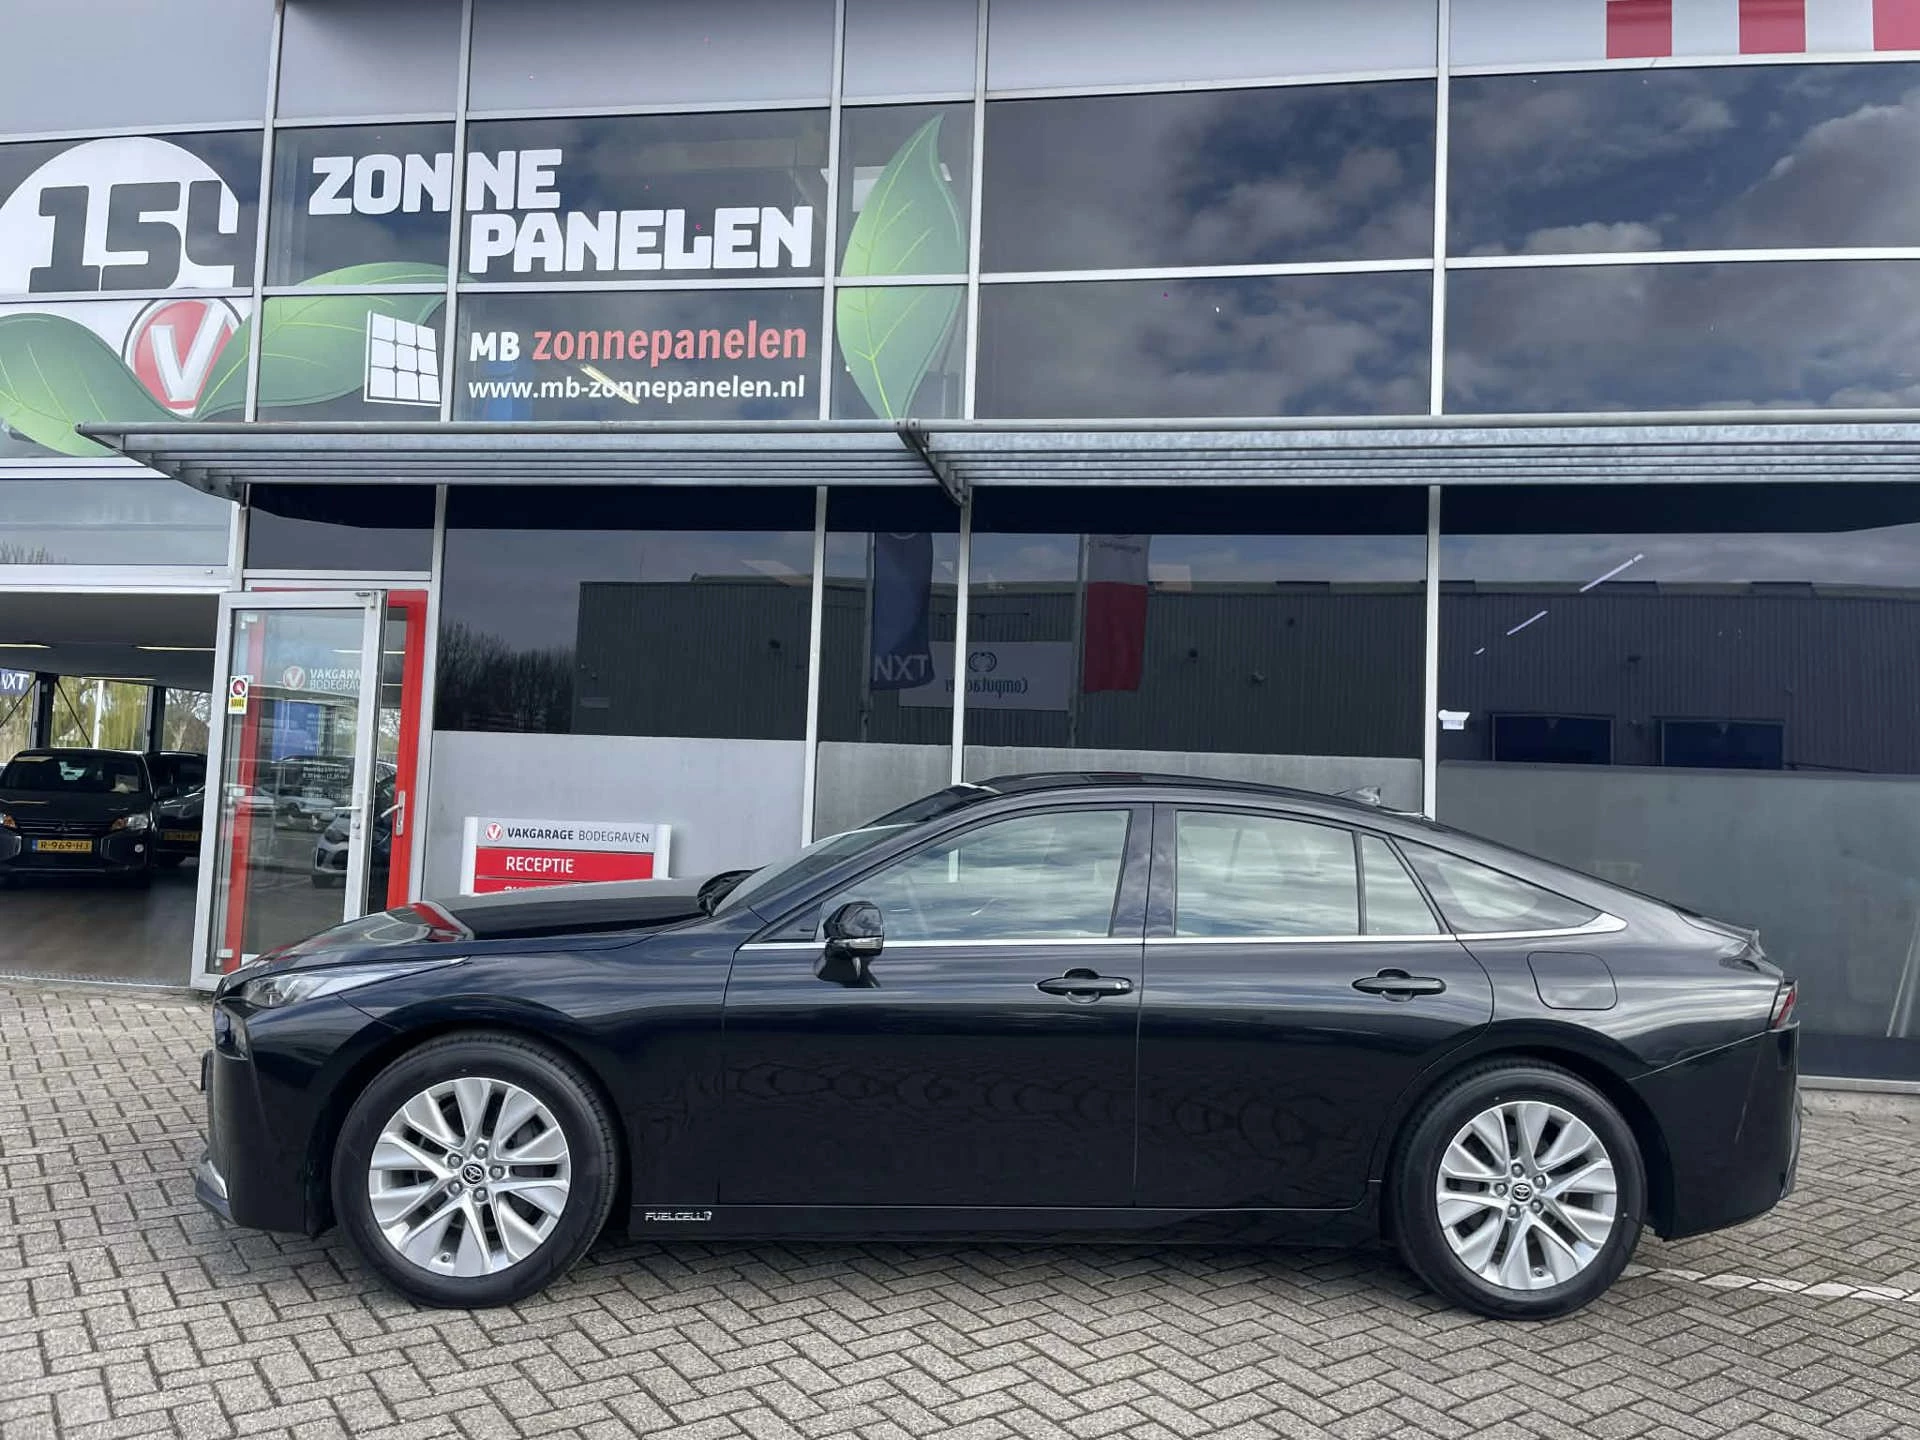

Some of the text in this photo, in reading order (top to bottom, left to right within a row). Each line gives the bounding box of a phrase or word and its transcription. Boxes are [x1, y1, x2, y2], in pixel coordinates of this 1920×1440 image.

[308, 148, 563, 216] ZONNE
[29, 180, 250, 293] 154
[468, 205, 814, 275] PANELEN
[469, 319, 808, 368] MB zonnepanelen
[467, 374, 805, 404] www.mb-zonnepanelen.nl
[873, 653, 929, 682] NXT
[507, 827, 574, 841] VAKGARAGE
[578, 829, 650, 844] BODEGRAVEN
[505, 855, 575, 874] RECEPTIE
